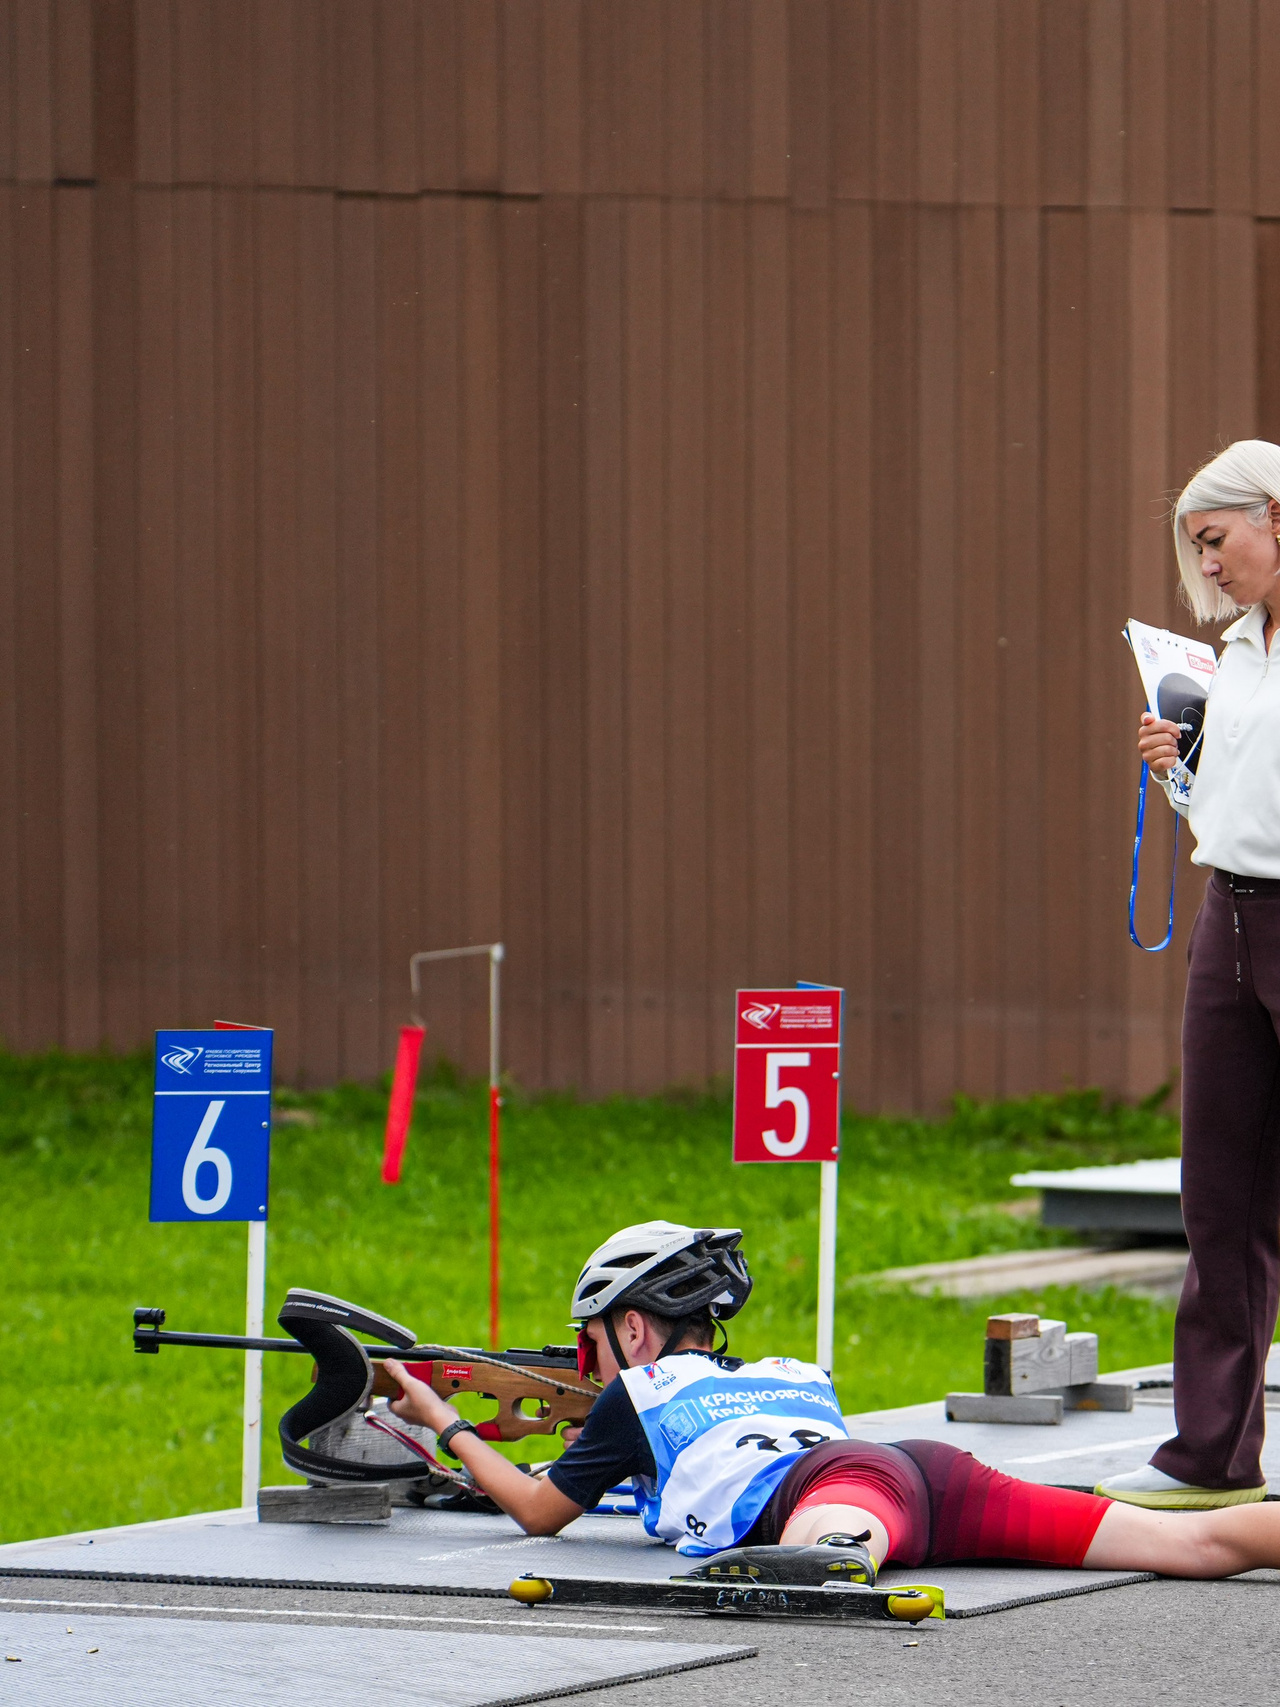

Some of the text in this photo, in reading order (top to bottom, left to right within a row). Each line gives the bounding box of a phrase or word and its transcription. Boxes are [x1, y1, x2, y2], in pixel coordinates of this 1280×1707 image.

[762, 1052, 810, 1157] 5
[182, 1100, 232, 1215] 6
[655, 1376, 677, 1390] СБР
[707, 1402, 760, 1421] КРАЙ
[686, 1514, 707, 1537] 8
